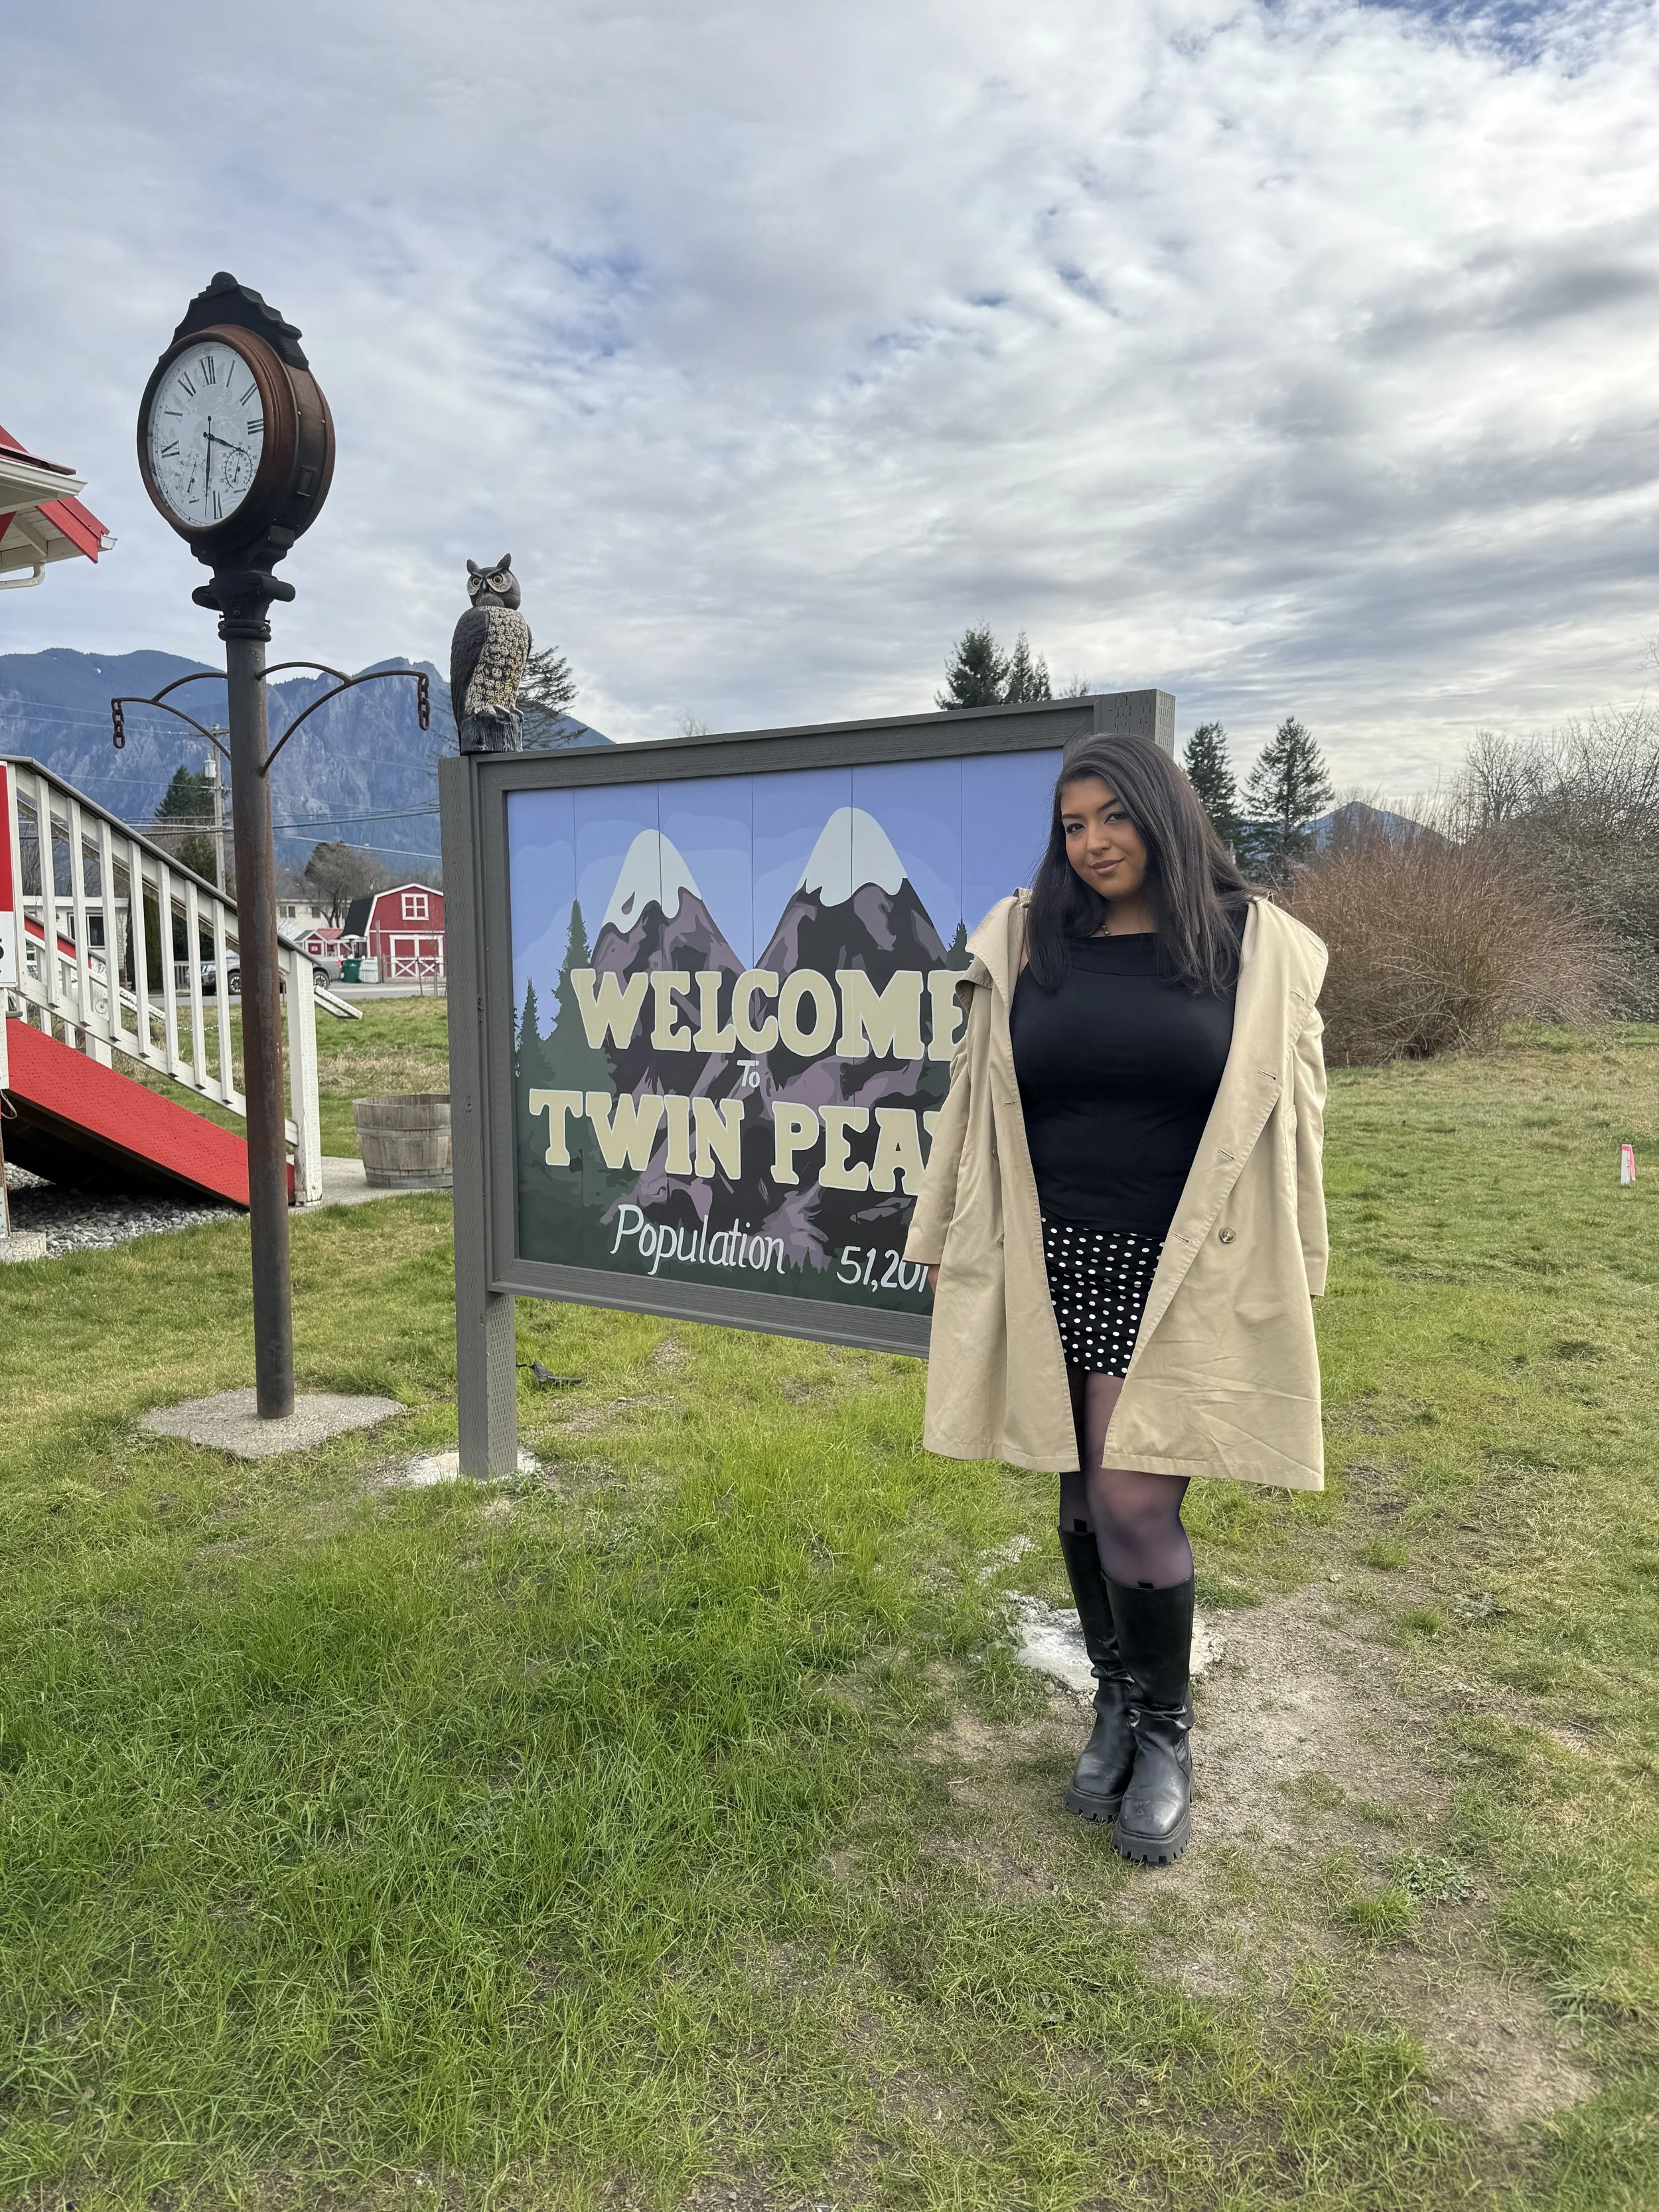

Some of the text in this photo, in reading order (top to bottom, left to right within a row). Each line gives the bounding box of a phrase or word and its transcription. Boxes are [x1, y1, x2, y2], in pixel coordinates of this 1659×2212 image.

[570, 968, 968, 1062] WELCOME
[737, 1059, 760, 1088] To
[529, 1088, 941, 1197] TWIN PEA
[610, 1203, 786, 1275] Population
